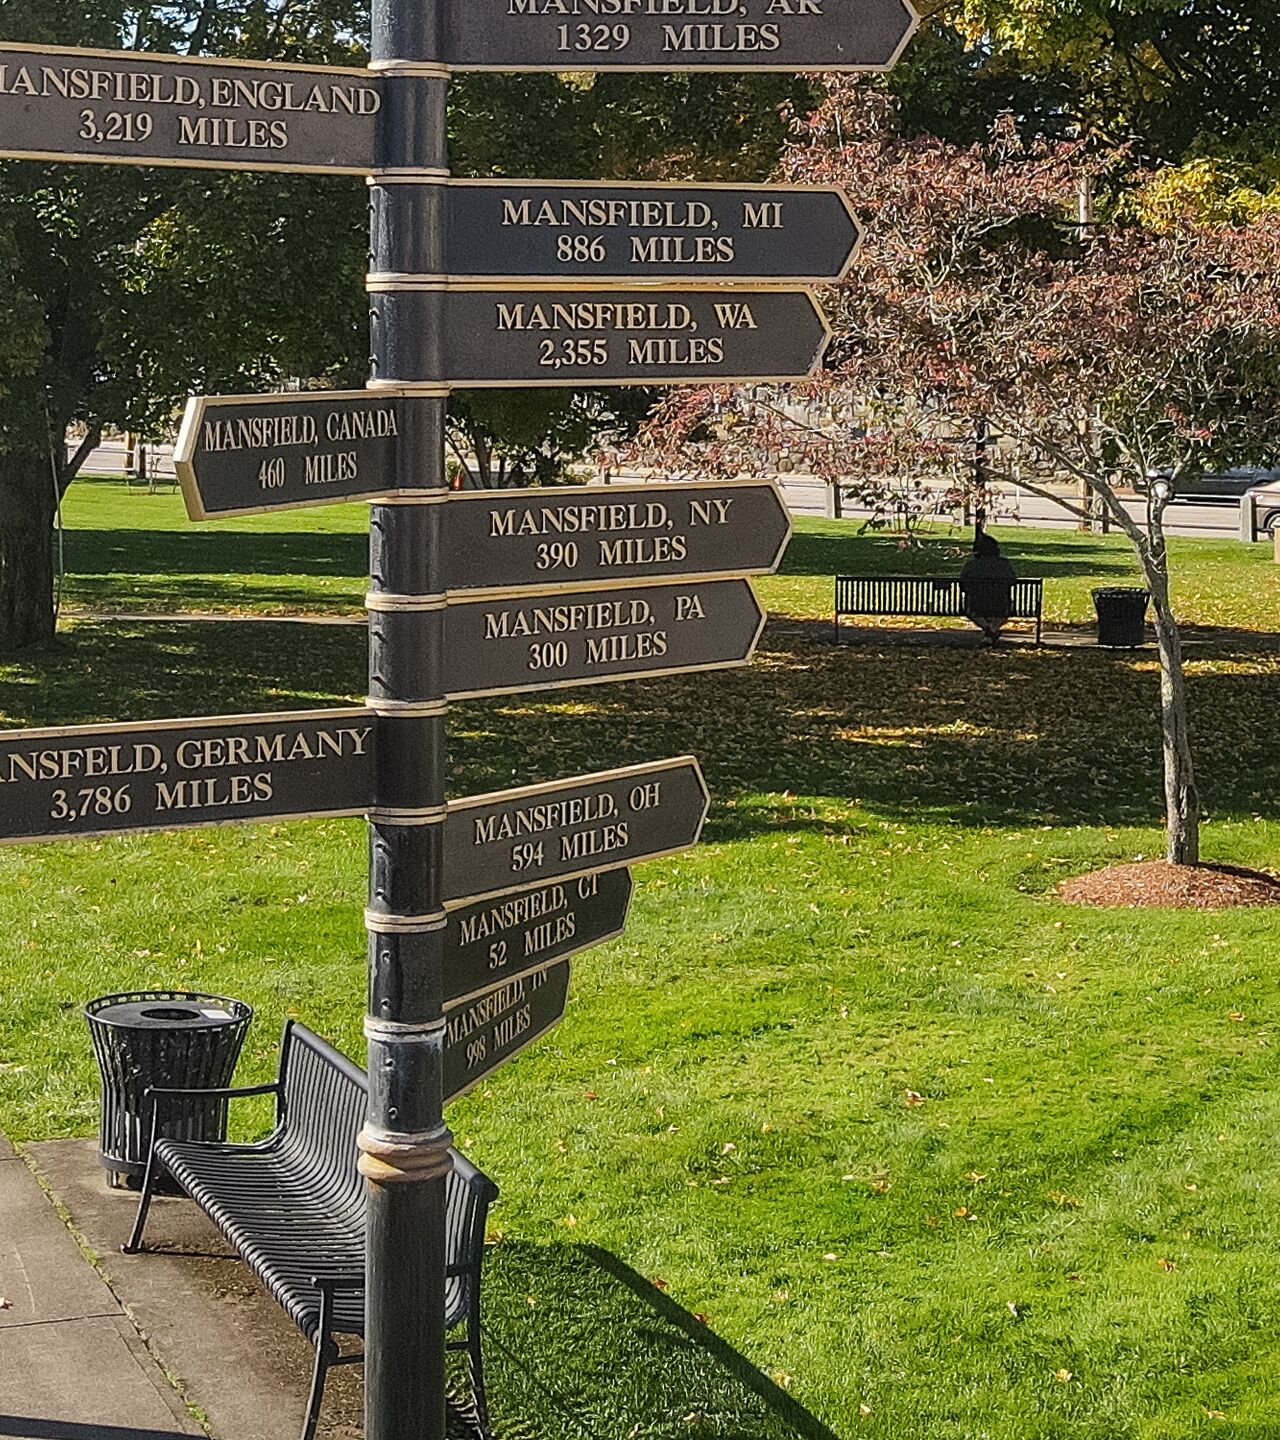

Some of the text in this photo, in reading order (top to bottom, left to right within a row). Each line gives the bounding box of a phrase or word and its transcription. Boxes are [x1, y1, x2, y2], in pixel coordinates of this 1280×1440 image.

[556, 23, 780, 52] 1329 MILES
[212, 79, 382, 115] ENGLAND
[79, 109, 289, 149] 3,219 MILES
[501, 198, 784, 231] MANSFIELD, MI
[556, 235, 735, 263] 886 MILES
[496, 303, 758, 333] MANSFIELD, WA
[538, 337, 724, 369] 2,355 MILES
[204, 409, 398, 452] MANSFIELD, CANADA
[258, 451, 358, 489] 460 MILES
[489, 498, 733, 537] MANSFIELD, NY
[536, 535, 687, 570] 390 MILES
[484, 594, 706, 640] MANSFIELD, PA
[528, 631, 668, 670] 300 MILES
[176, 727, 373, 769] GERMANY
[50, 772, 274, 822] 3,786 MILES
[474, 782, 661, 845] MANSFIELD, OH
[511, 822, 628, 872] 594 MILES
[459, 874, 601, 946] MANSFIELD, CT
[489, 912, 576, 969] 52 MILES
[446, 978, 526, 1049] MANSFIELD,
[466, 1003, 531, 1071] 998 MILES
